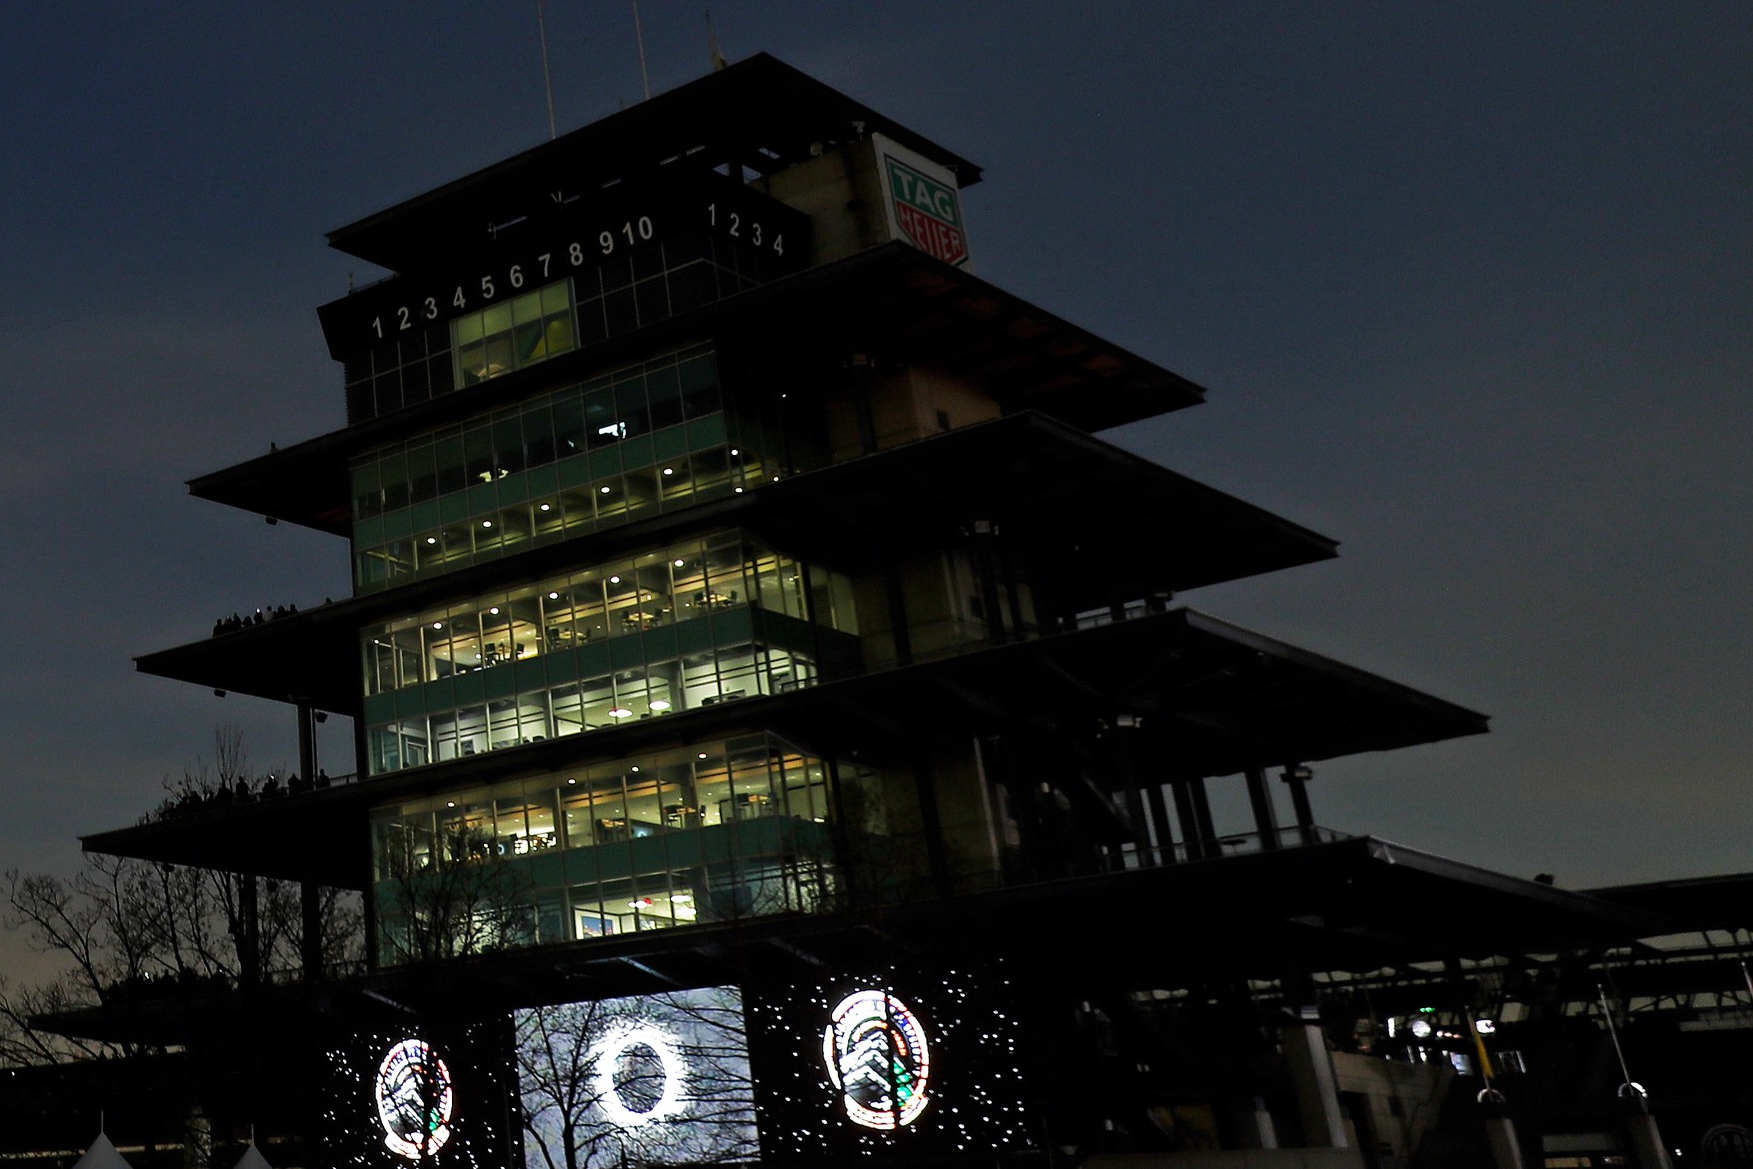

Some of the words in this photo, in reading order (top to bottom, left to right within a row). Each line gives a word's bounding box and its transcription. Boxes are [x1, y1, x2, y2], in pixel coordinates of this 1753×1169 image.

[893, 168, 951, 222] TAG
[708, 202, 715, 227] 1
[729, 212, 740, 238] 2
[752, 222, 762, 247] 3
[773, 233, 784, 258] 4
[372, 316, 383, 339] 1
[397, 306, 412, 331] 2
[424, 296, 438, 320] 3
[452, 285, 466, 309] 4
[481, 275, 495, 299] 5
[509, 264, 524, 288] 6
[538, 252, 551, 277] 7
[568, 241, 584, 267] 8
[599, 230, 614, 255] 9
[622, 215, 654, 246] 10
